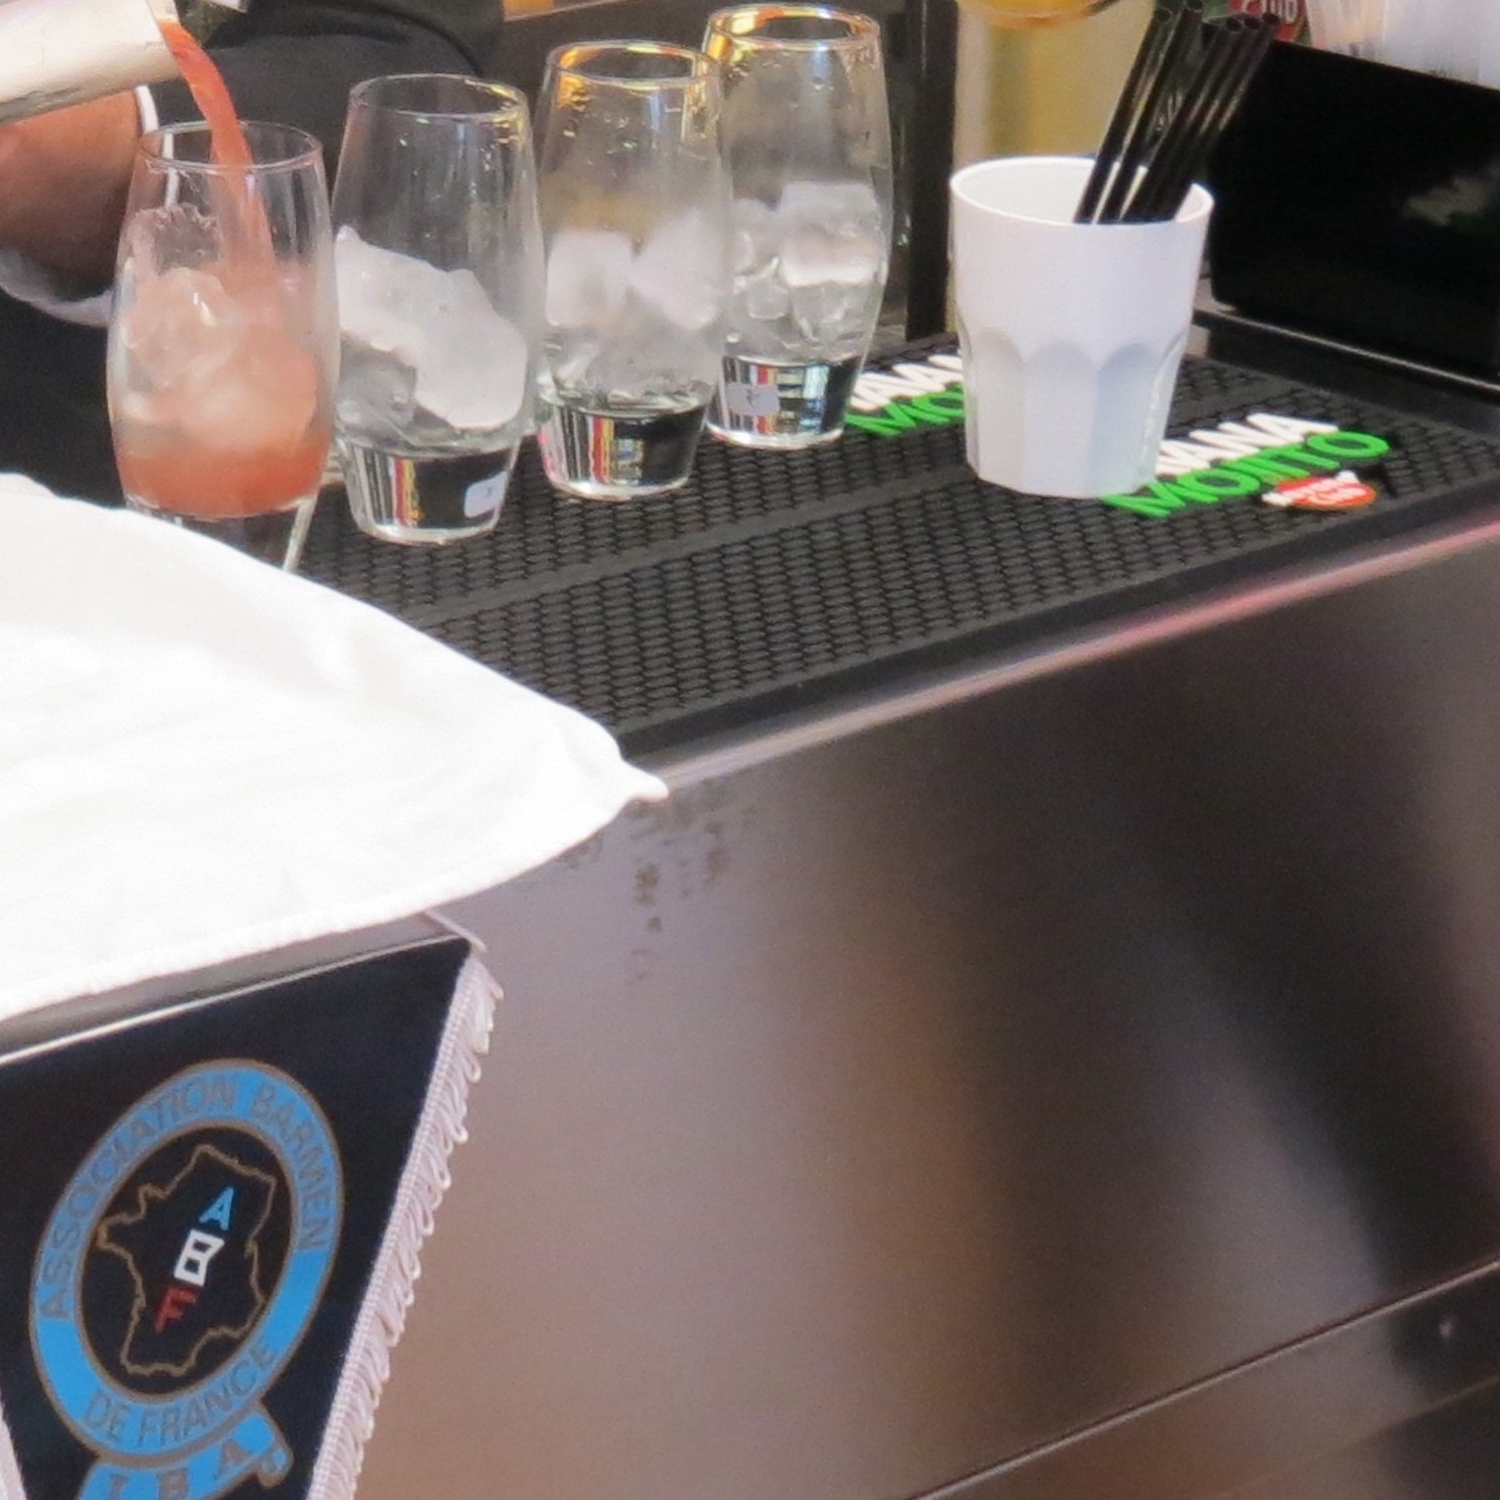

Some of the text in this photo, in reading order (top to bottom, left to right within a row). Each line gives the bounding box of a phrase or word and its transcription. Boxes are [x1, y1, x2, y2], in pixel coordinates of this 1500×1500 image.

[38, 1073, 330, 1320] ASSOCIATION BARMEN
[83, 1342, 275, 1448] DE FRANCE
